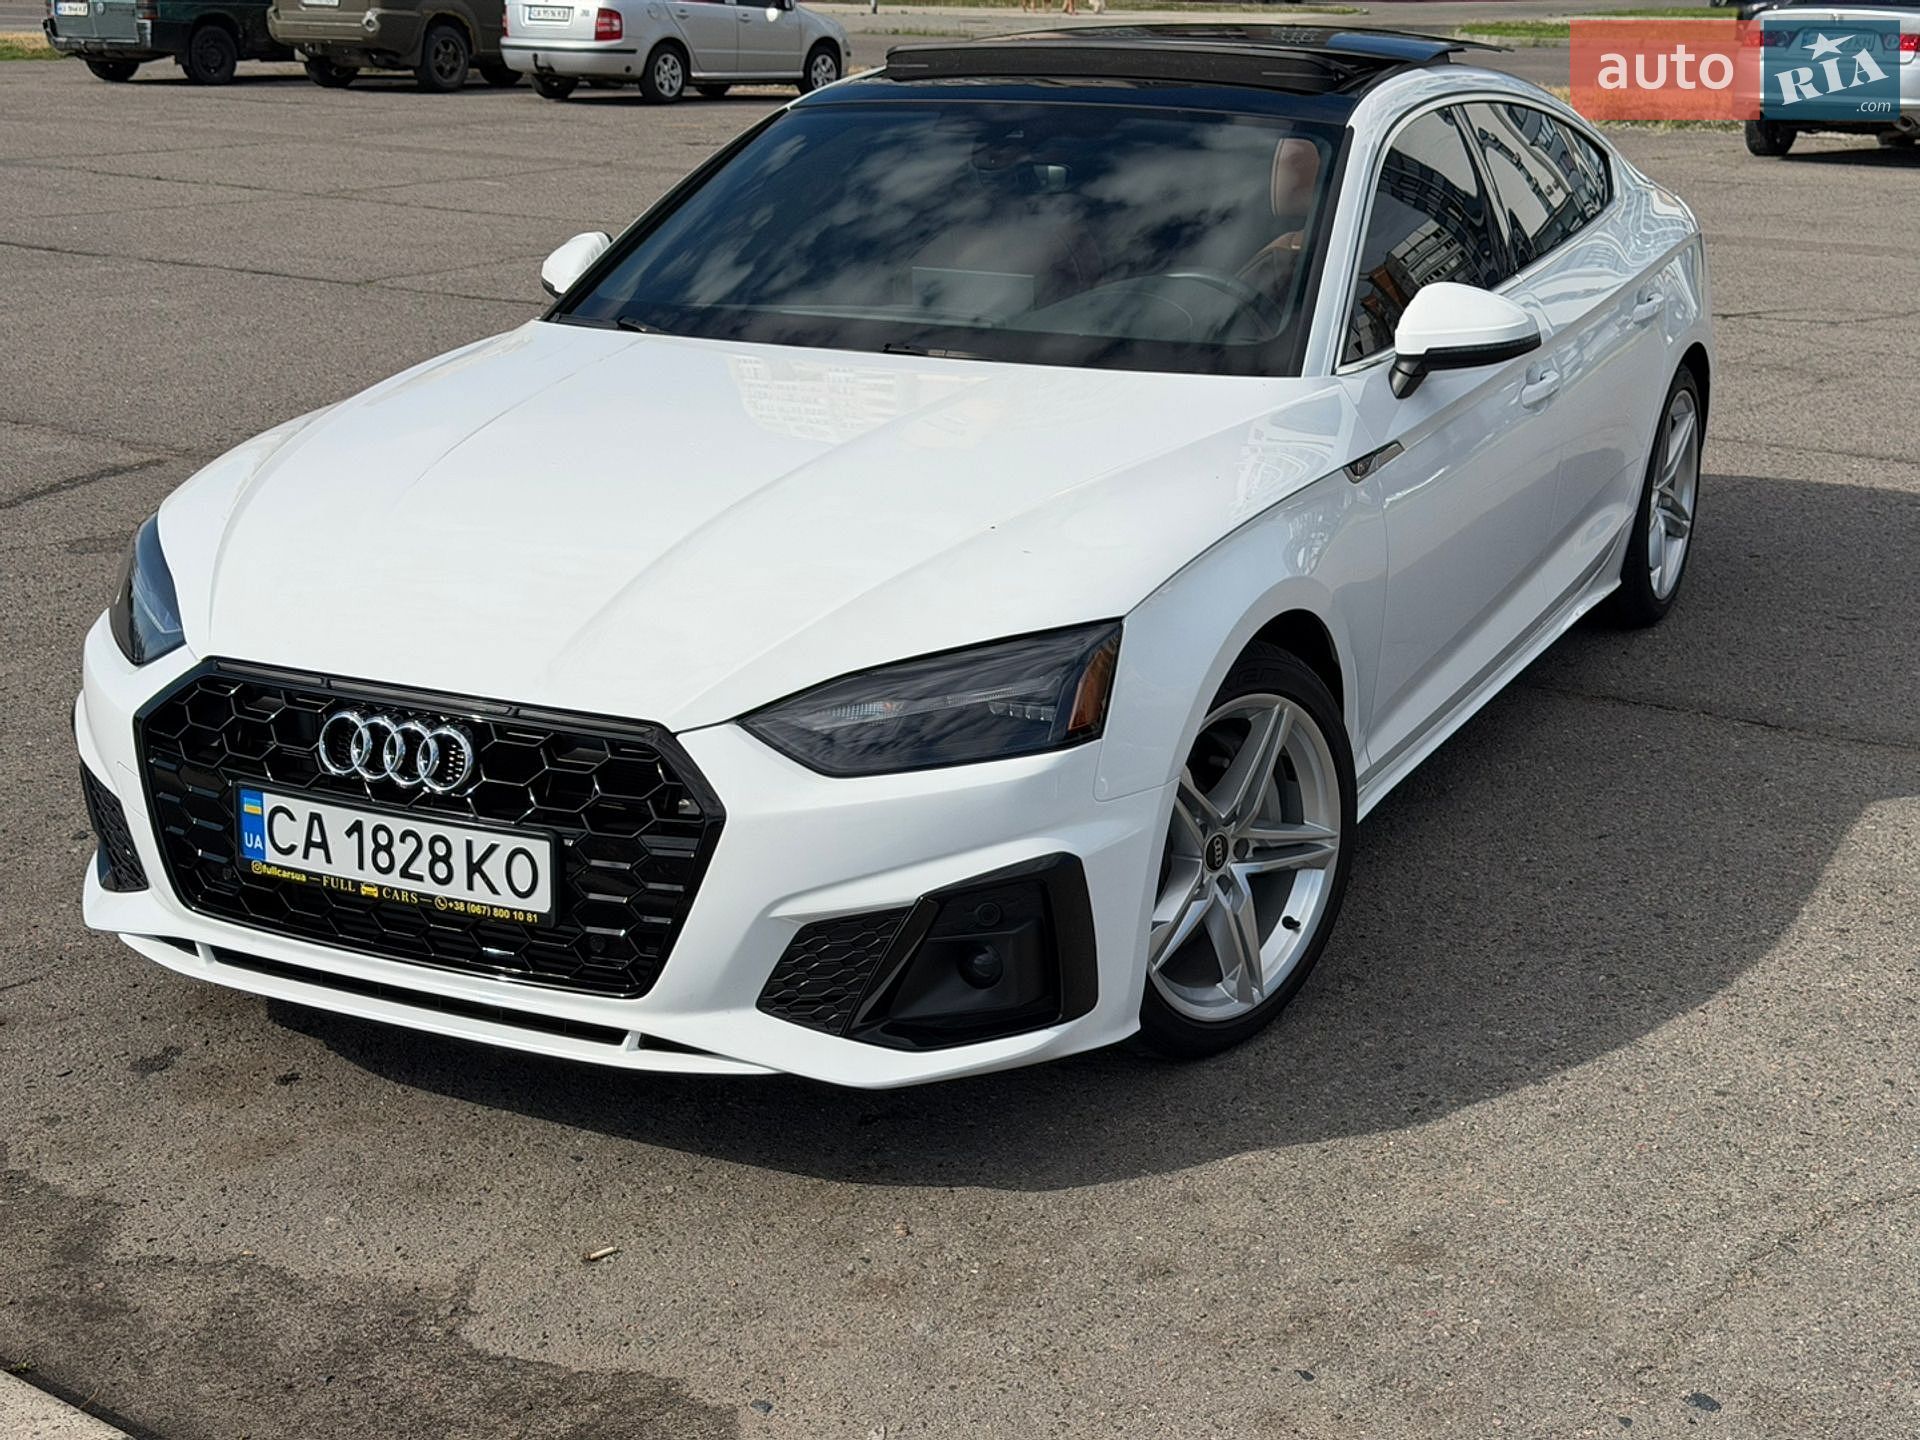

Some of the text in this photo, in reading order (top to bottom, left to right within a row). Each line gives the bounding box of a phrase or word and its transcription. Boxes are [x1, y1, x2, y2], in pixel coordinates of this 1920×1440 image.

[244, 831, 264, 850] UA
[267, 805, 539, 899] CA 1828 KO
[322, 875, 356, 892] FULL
[382, 887, 418, 904] CARS
[513, 911, 524, 921] 10
[526, 912, 538, 923] 81
